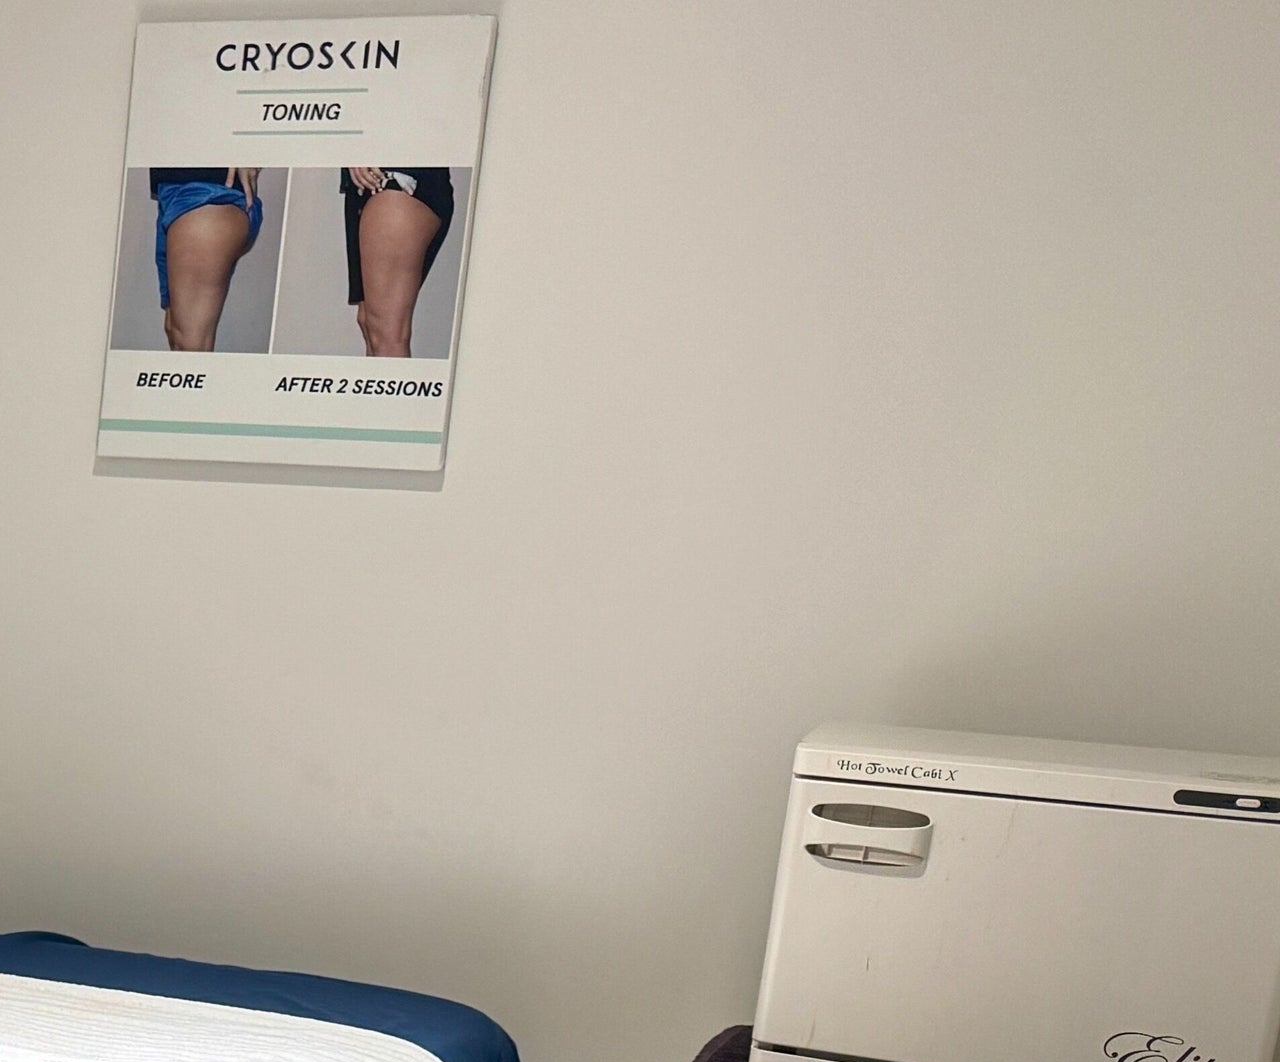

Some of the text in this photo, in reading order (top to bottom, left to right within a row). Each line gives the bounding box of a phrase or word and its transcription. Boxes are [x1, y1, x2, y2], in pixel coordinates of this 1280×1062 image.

[262, 103, 341, 122] TONING
[136, 372, 206, 389] BEFORE
[275, 377, 443, 398] AFTER 2 SESSIONS
[837, 760, 959, 781] Hot Towel Cabi X
